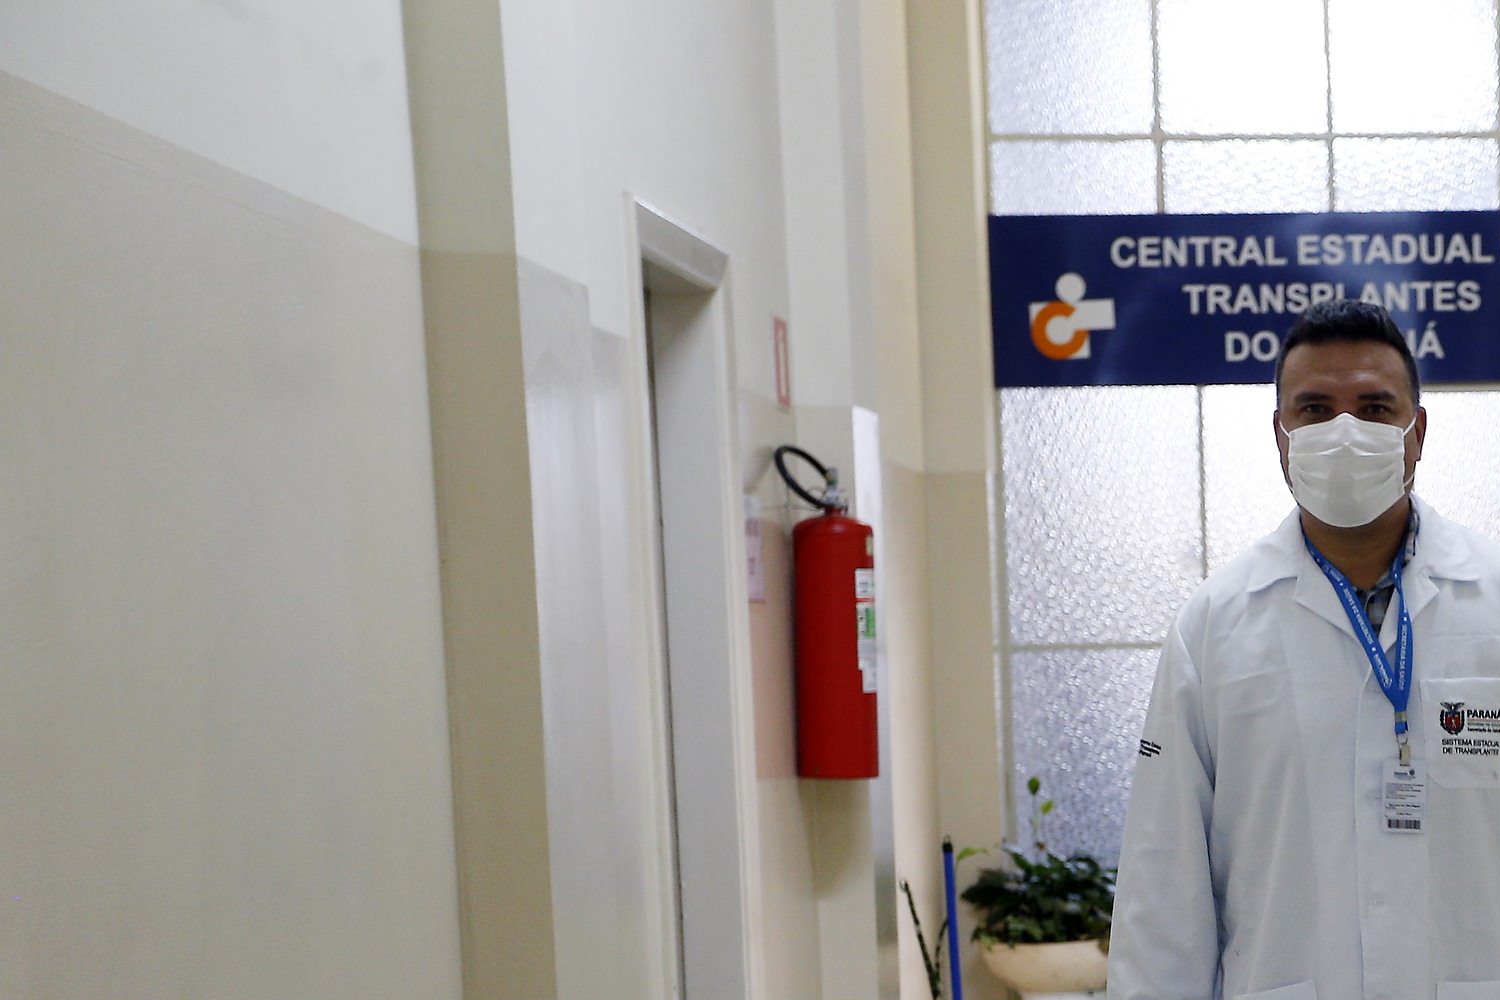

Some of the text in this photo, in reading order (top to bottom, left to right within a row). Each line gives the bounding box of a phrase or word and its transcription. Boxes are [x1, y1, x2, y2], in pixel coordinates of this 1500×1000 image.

[1110, 236, 1288, 268] CENTRAL
[1296, 234, 1495, 265] ESTADUAL
[1224, 330, 1281, 362] DO
[1442, 739, 1473, 747] SISTEMA
[1442, 747, 1453, 755] DE
